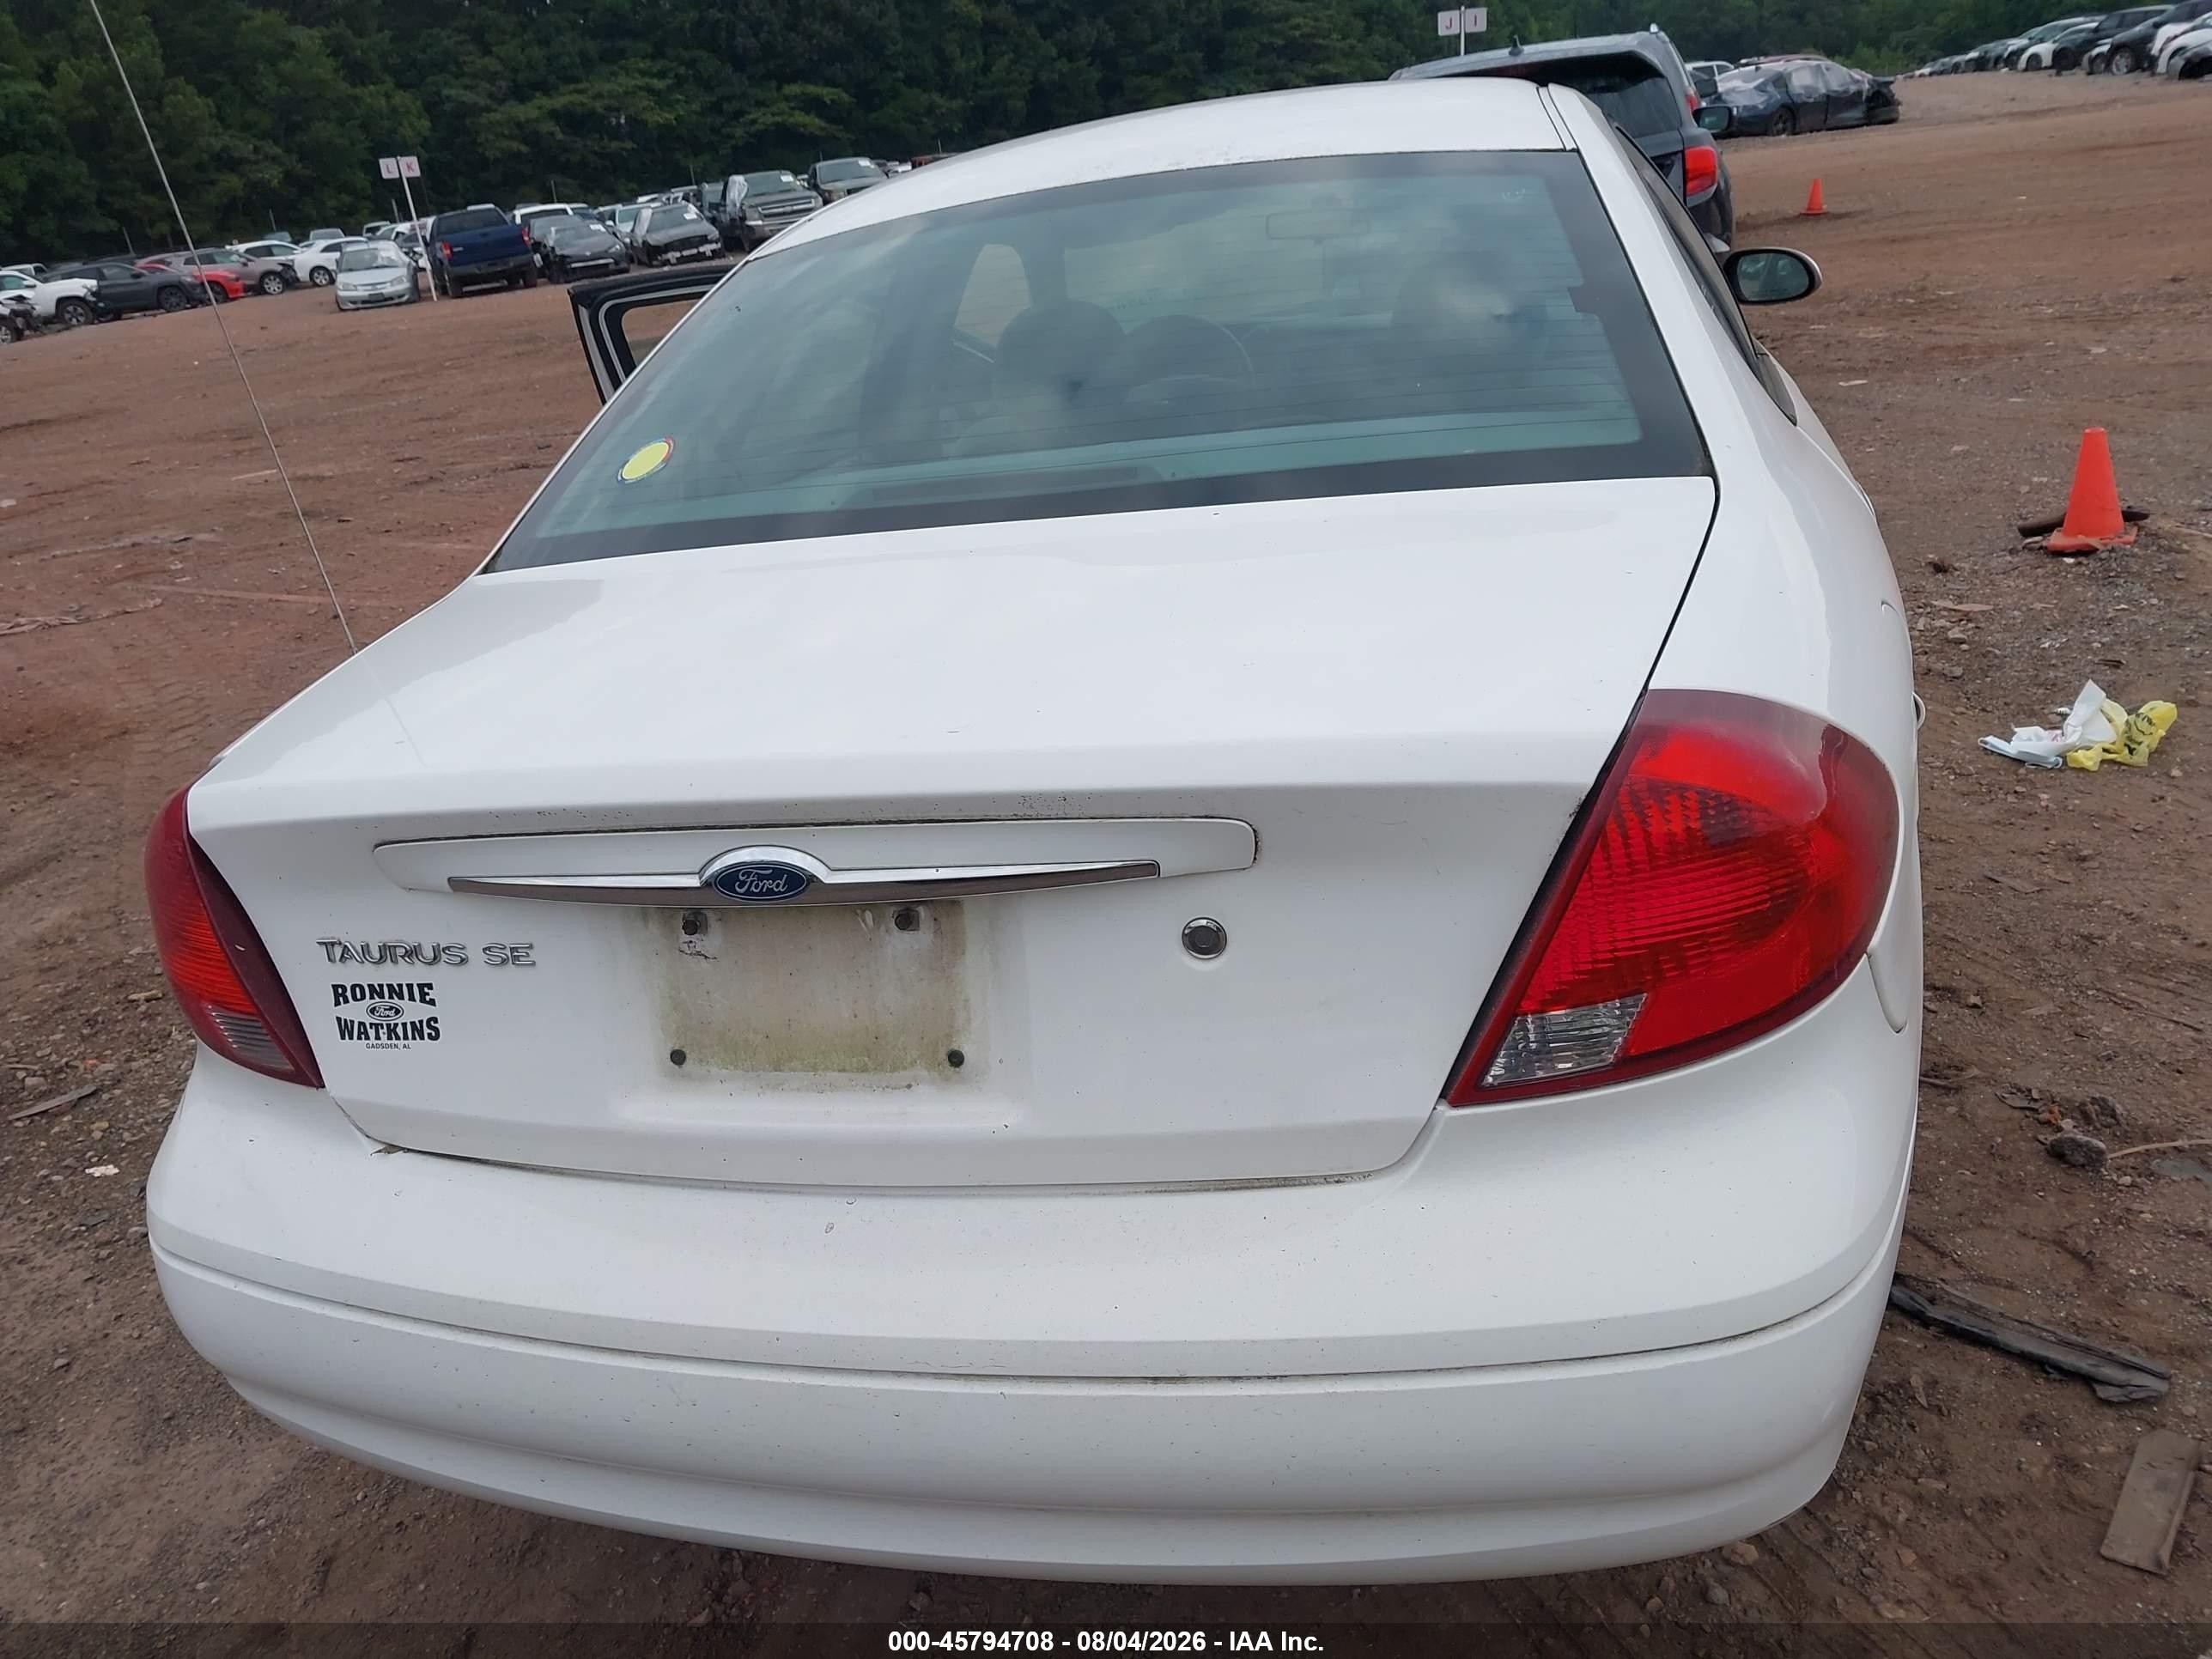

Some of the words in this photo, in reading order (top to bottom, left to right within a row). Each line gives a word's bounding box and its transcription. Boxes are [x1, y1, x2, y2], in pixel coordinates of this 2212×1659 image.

[1445, 16, 1452, 30] J
[405, 161, 415, 173] K
[734, 868, 788, 894] Ford
[316, 937, 469, 967] TAURUS
[482, 942, 536, 967] SE
[331, 981, 437, 1008] RONNIE
[374, 1006, 396, 1017] Ford
[335, 1016, 441, 1042] WATKINS
[365, 1042, 401, 1051] GADSDEN,
